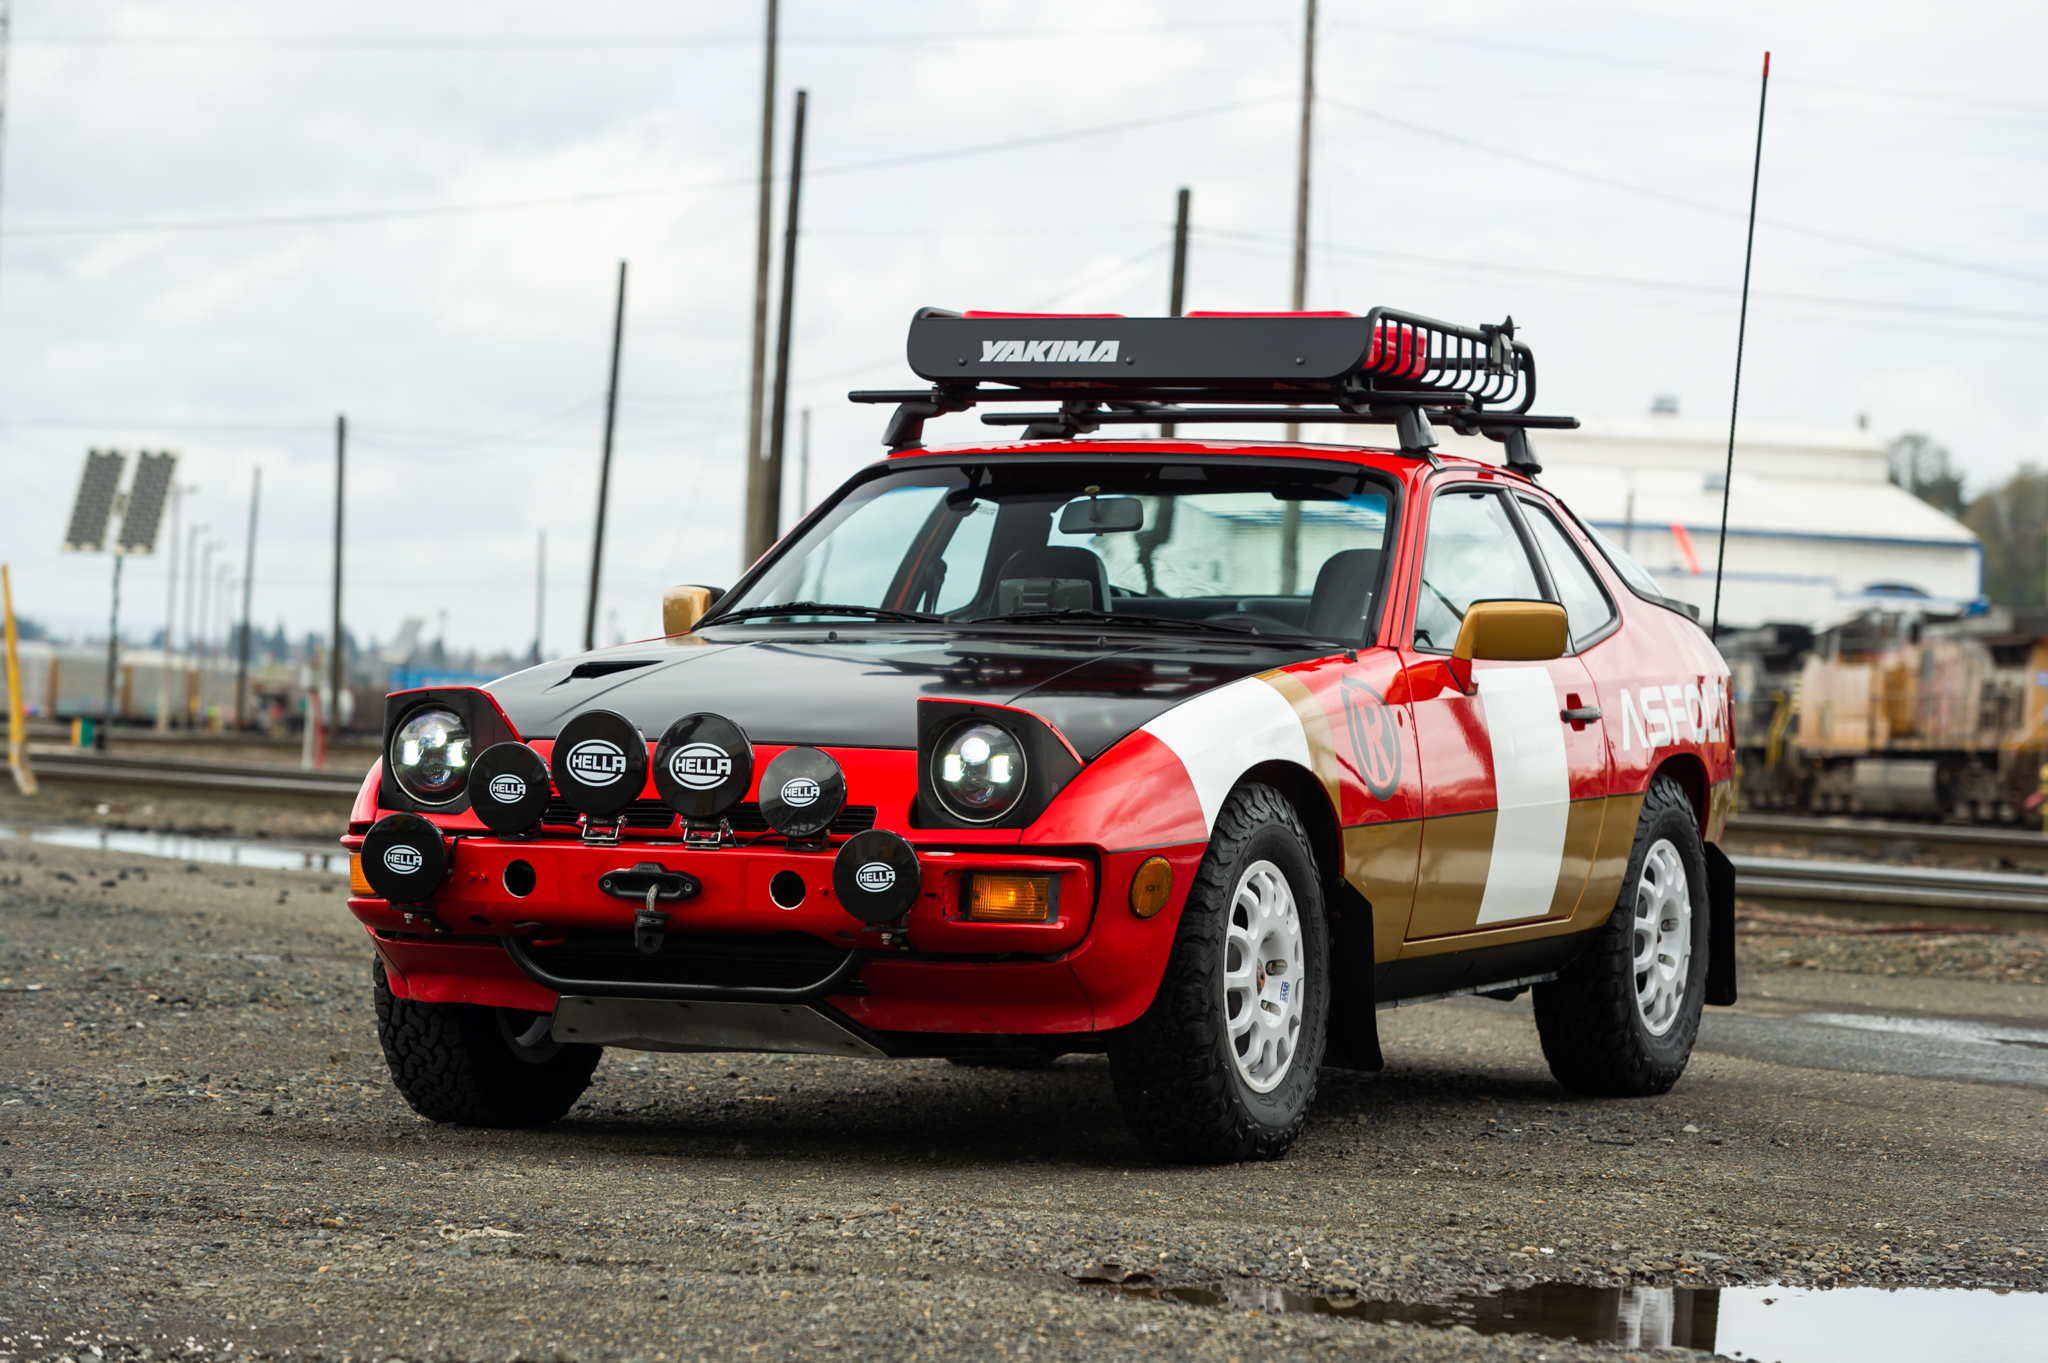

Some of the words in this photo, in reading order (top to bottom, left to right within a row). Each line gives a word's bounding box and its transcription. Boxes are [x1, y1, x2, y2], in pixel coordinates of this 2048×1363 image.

[979, 340, 1120, 363] YAKIMA
[573, 753, 627, 774] HELLA
[675, 757, 732, 776] HELLA
[493, 782, 527, 795] HELLA
[784, 785, 820, 798] HELLA
[387, 853, 423, 867] HELLA
[859, 870, 895, 884] HELLA
